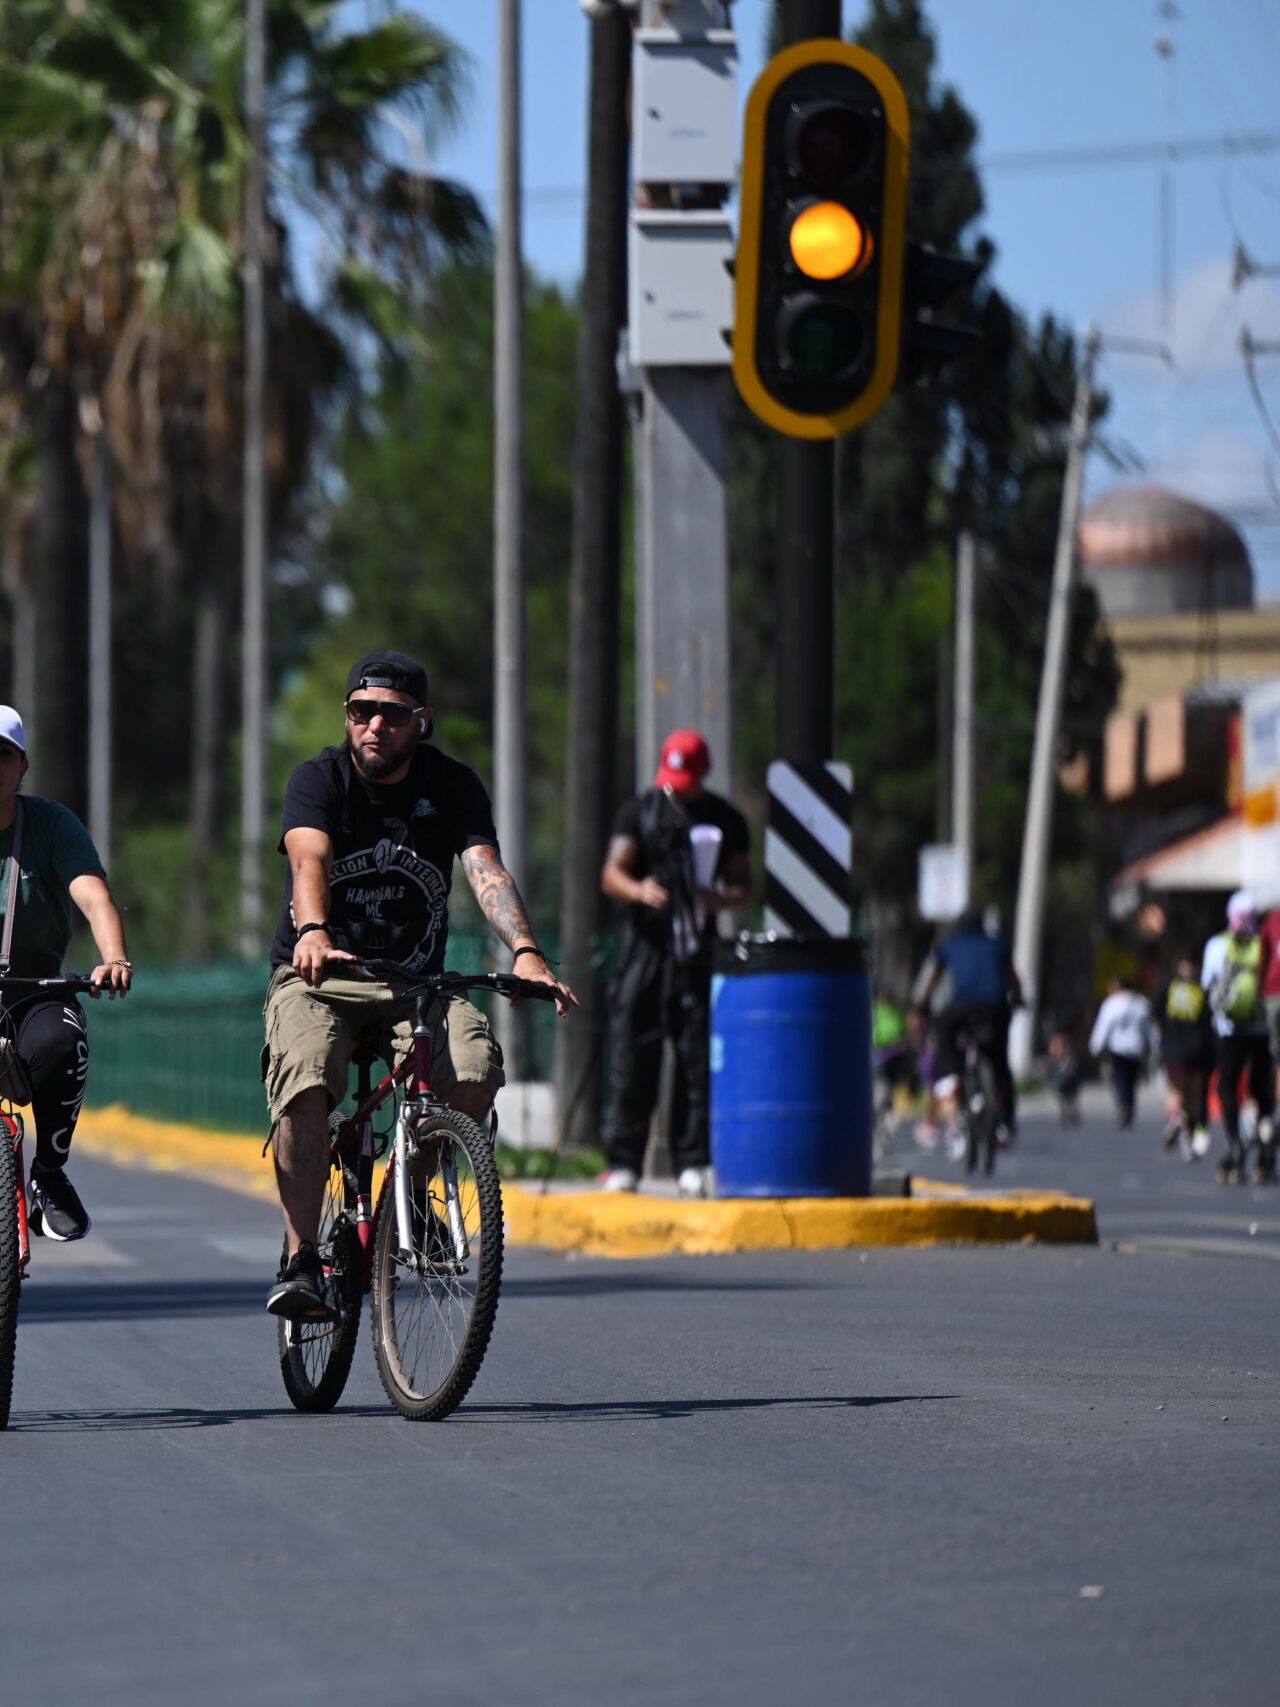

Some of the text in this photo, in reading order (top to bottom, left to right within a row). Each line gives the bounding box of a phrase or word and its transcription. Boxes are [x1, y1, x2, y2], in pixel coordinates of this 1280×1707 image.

[400, 853, 444, 897] INTERNA
[366, 902, 383, 918] MC
[51, 1040, 89, 1154] Clin
